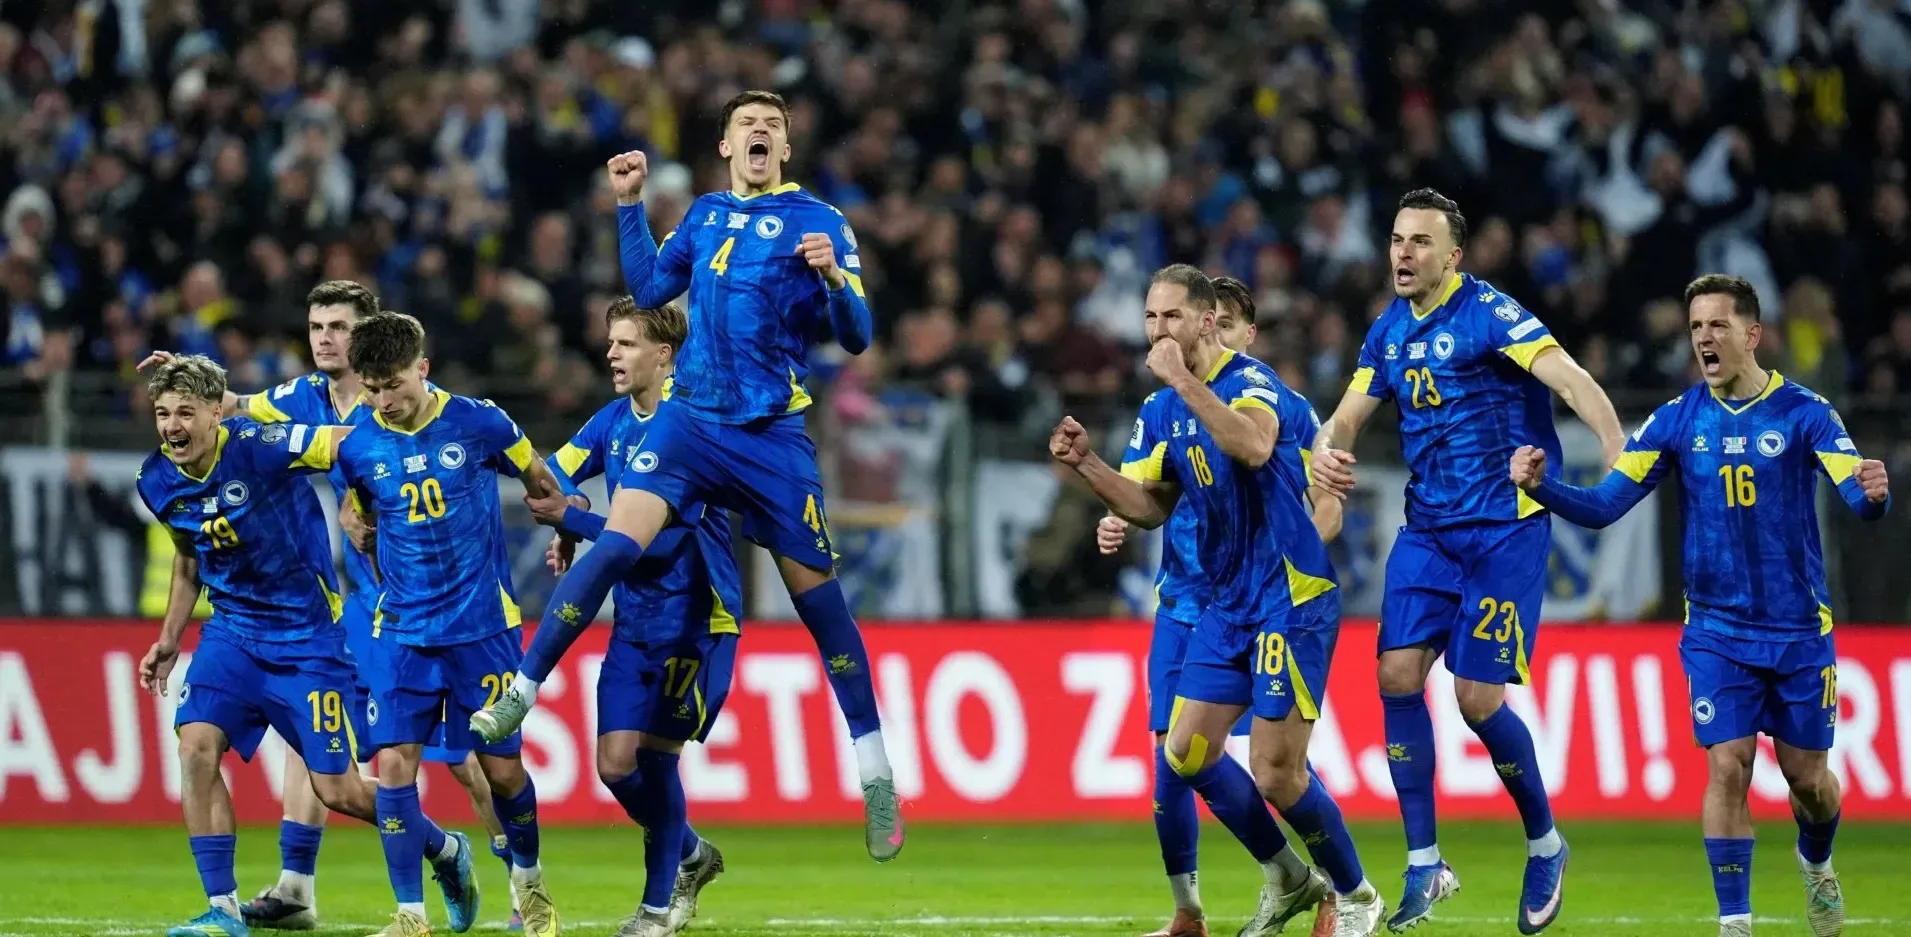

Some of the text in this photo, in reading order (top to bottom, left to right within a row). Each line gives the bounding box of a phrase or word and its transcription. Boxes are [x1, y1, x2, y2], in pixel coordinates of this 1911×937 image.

[709, 237, 735, 276] 4
[1404, 366, 1442, 409] 23
[1186, 445, 1214, 488] 18
[1718, 464, 1757, 507] 16
[400, 478, 446, 524] 20
[803, 494, 820, 535] 4
[200, 516, 240, 550] 19
[1472, 597, 1516, 644] 23
[1255, 631, 1285, 676] 18
[664, 656, 699, 699] 17
[1820, 664, 1838, 709] 16
[308, 690, 341, 733] 19
